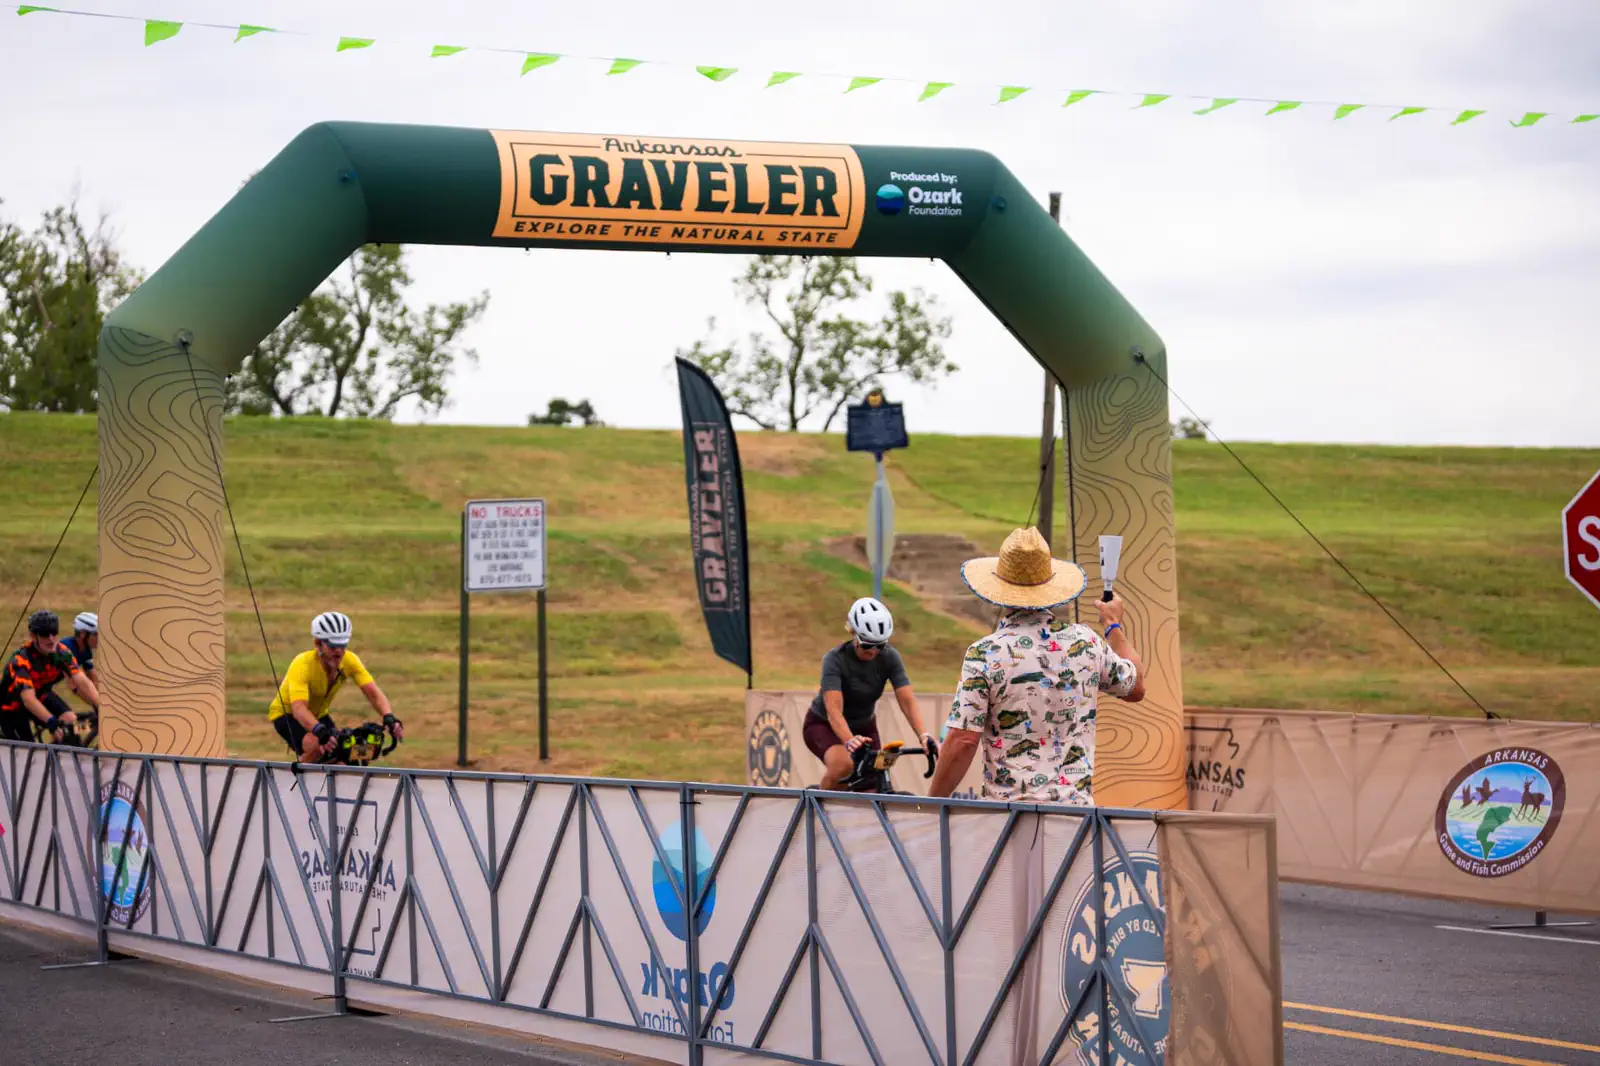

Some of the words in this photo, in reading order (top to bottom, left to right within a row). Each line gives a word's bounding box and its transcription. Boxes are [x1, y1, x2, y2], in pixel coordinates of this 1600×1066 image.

[603, 137, 742, 157] Arkansas
[529, 153, 840, 217] GRAVELER
[890, 171, 939, 182] Produced
[941, 173, 958, 184] by:
[908, 186, 962, 205] Ozark
[908, 205, 962, 216] Foundation
[514, 221, 611, 235] EXPLORE
[624, 225, 661, 237] THE
[671, 227, 765, 241] NATURAL
[777, 230, 838, 243] STATE
[471, 507, 487, 518] NO
[694, 428, 729, 603] GRAVELER
[1485, 749, 1548, 769] ARKANSAS
[1186, 760, 1246, 789] ANSAS
[1440, 833, 1456, 860] Game
[1456, 857, 1471, 871] and
[1472, 861, 1489, 875] Fish
[1490, 840, 1544, 875] Commission
